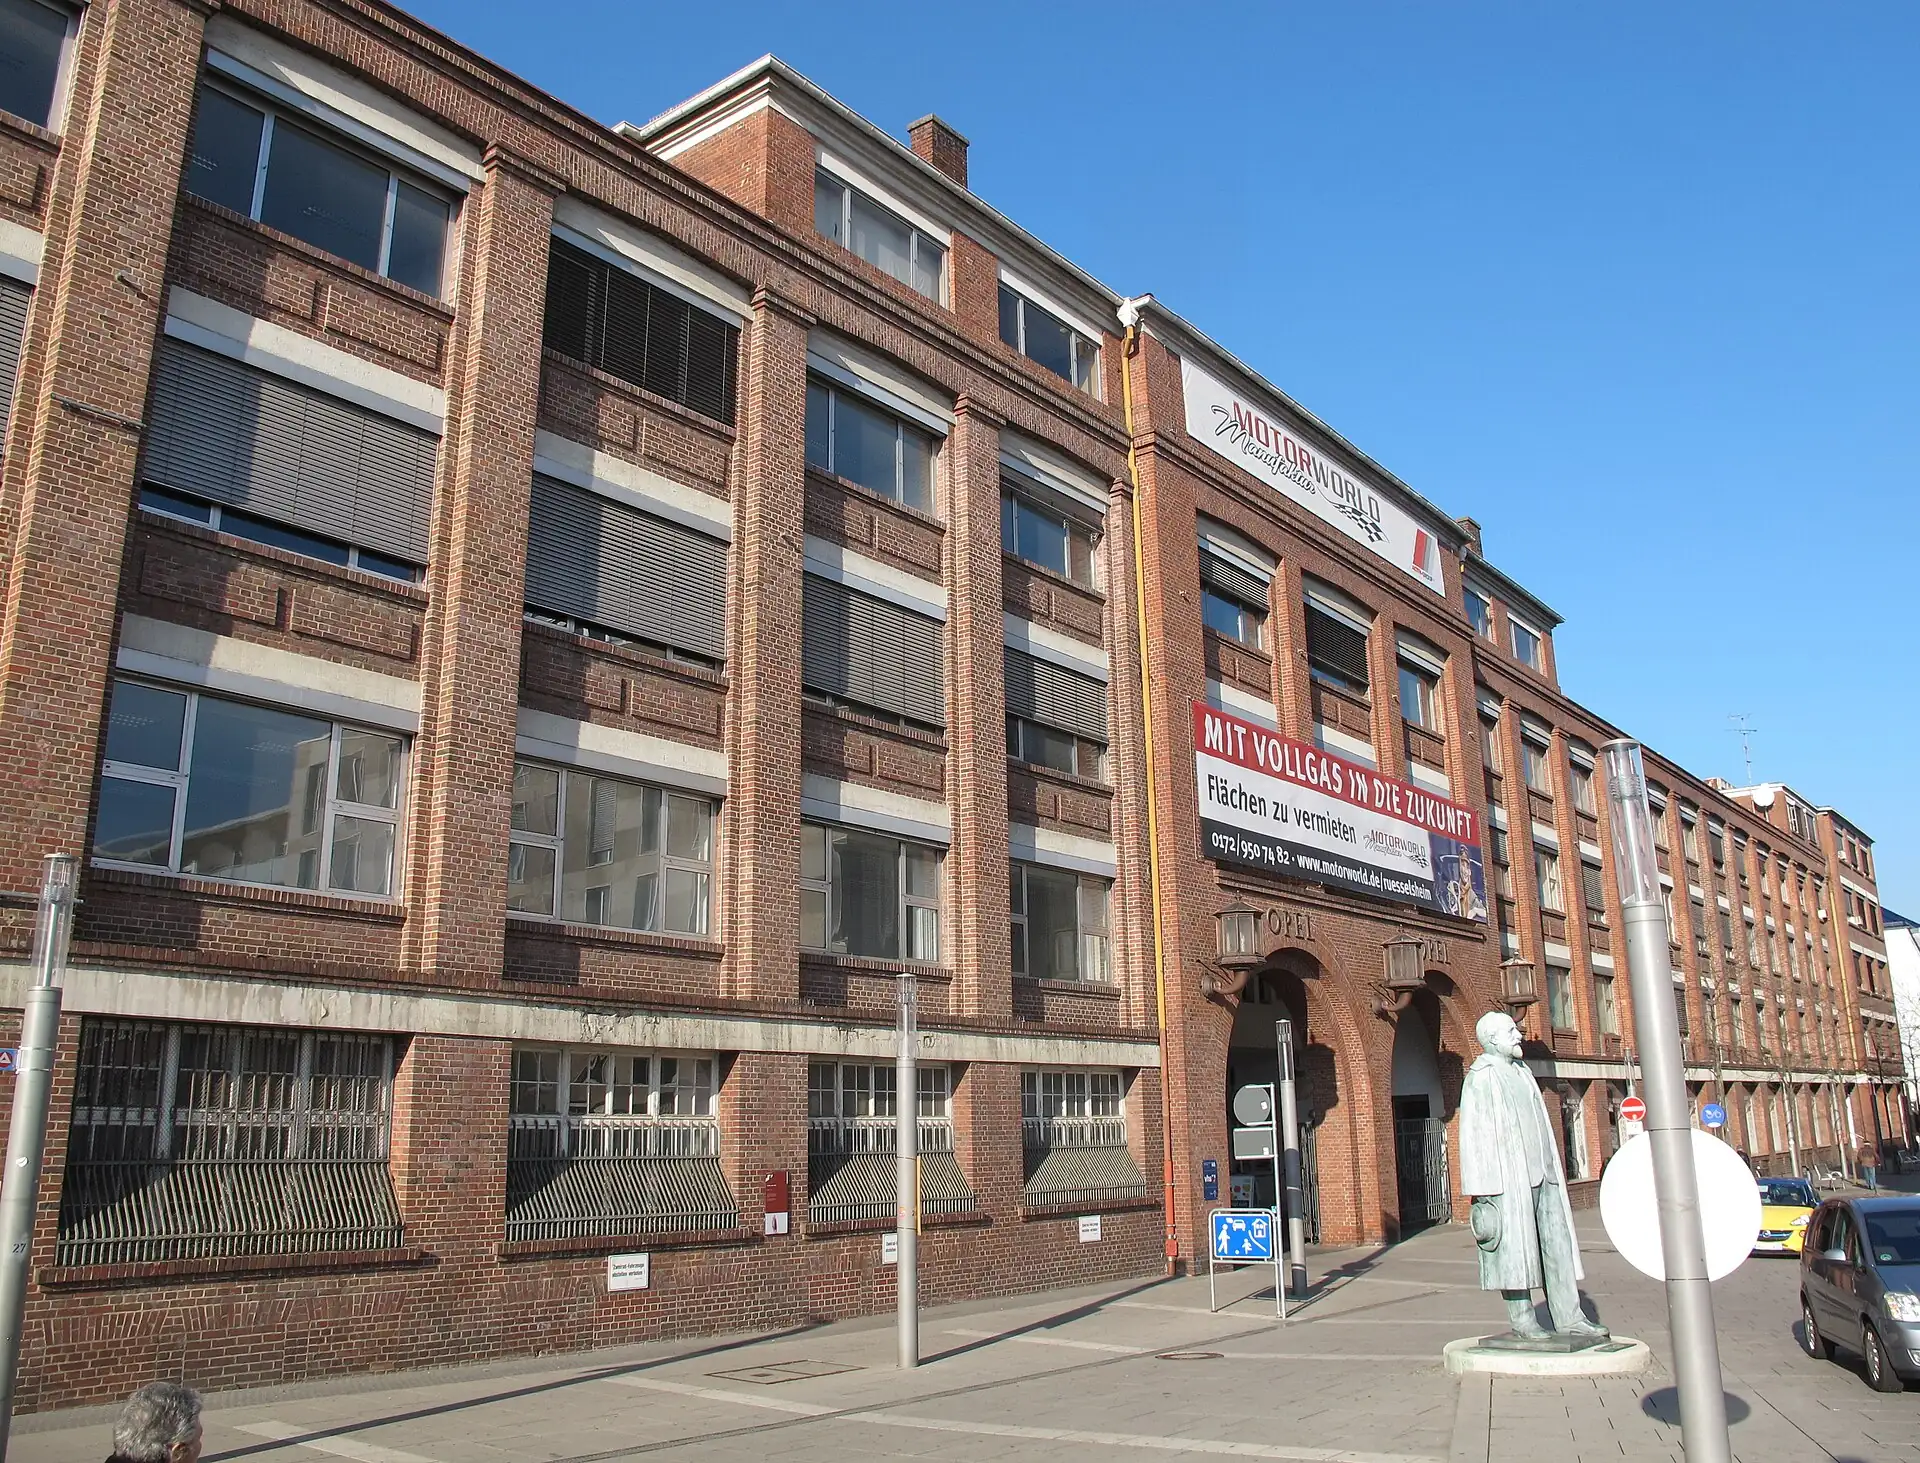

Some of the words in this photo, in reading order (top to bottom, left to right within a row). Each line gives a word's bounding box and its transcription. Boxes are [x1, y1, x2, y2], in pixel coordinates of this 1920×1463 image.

[1210, 404, 1316, 495] Manufaktur
[1232, 400, 1381, 523] MOTORWORLD
[1203, 713, 1247, 760] MIT
[1252, 731, 1343, 795] VOLLGAS
[1348, 768, 1368, 803] IN
[1373, 777, 1402, 815] DIE
[1405, 788, 1472, 840] ZUKUNFT
[1207, 773, 1267, 818] Flächen
[1272, 800, 1289, 824] zu
[1294, 808, 1357, 845] vermieten
[1261, 846, 1276, 866] 74
[1277, 845, 1290, 866] 82
[1370, 829, 1426, 858] MOTORWORLD
[1266, 907, 1316, 942] OPEL
[12, 1242, 27, 1254] 27
